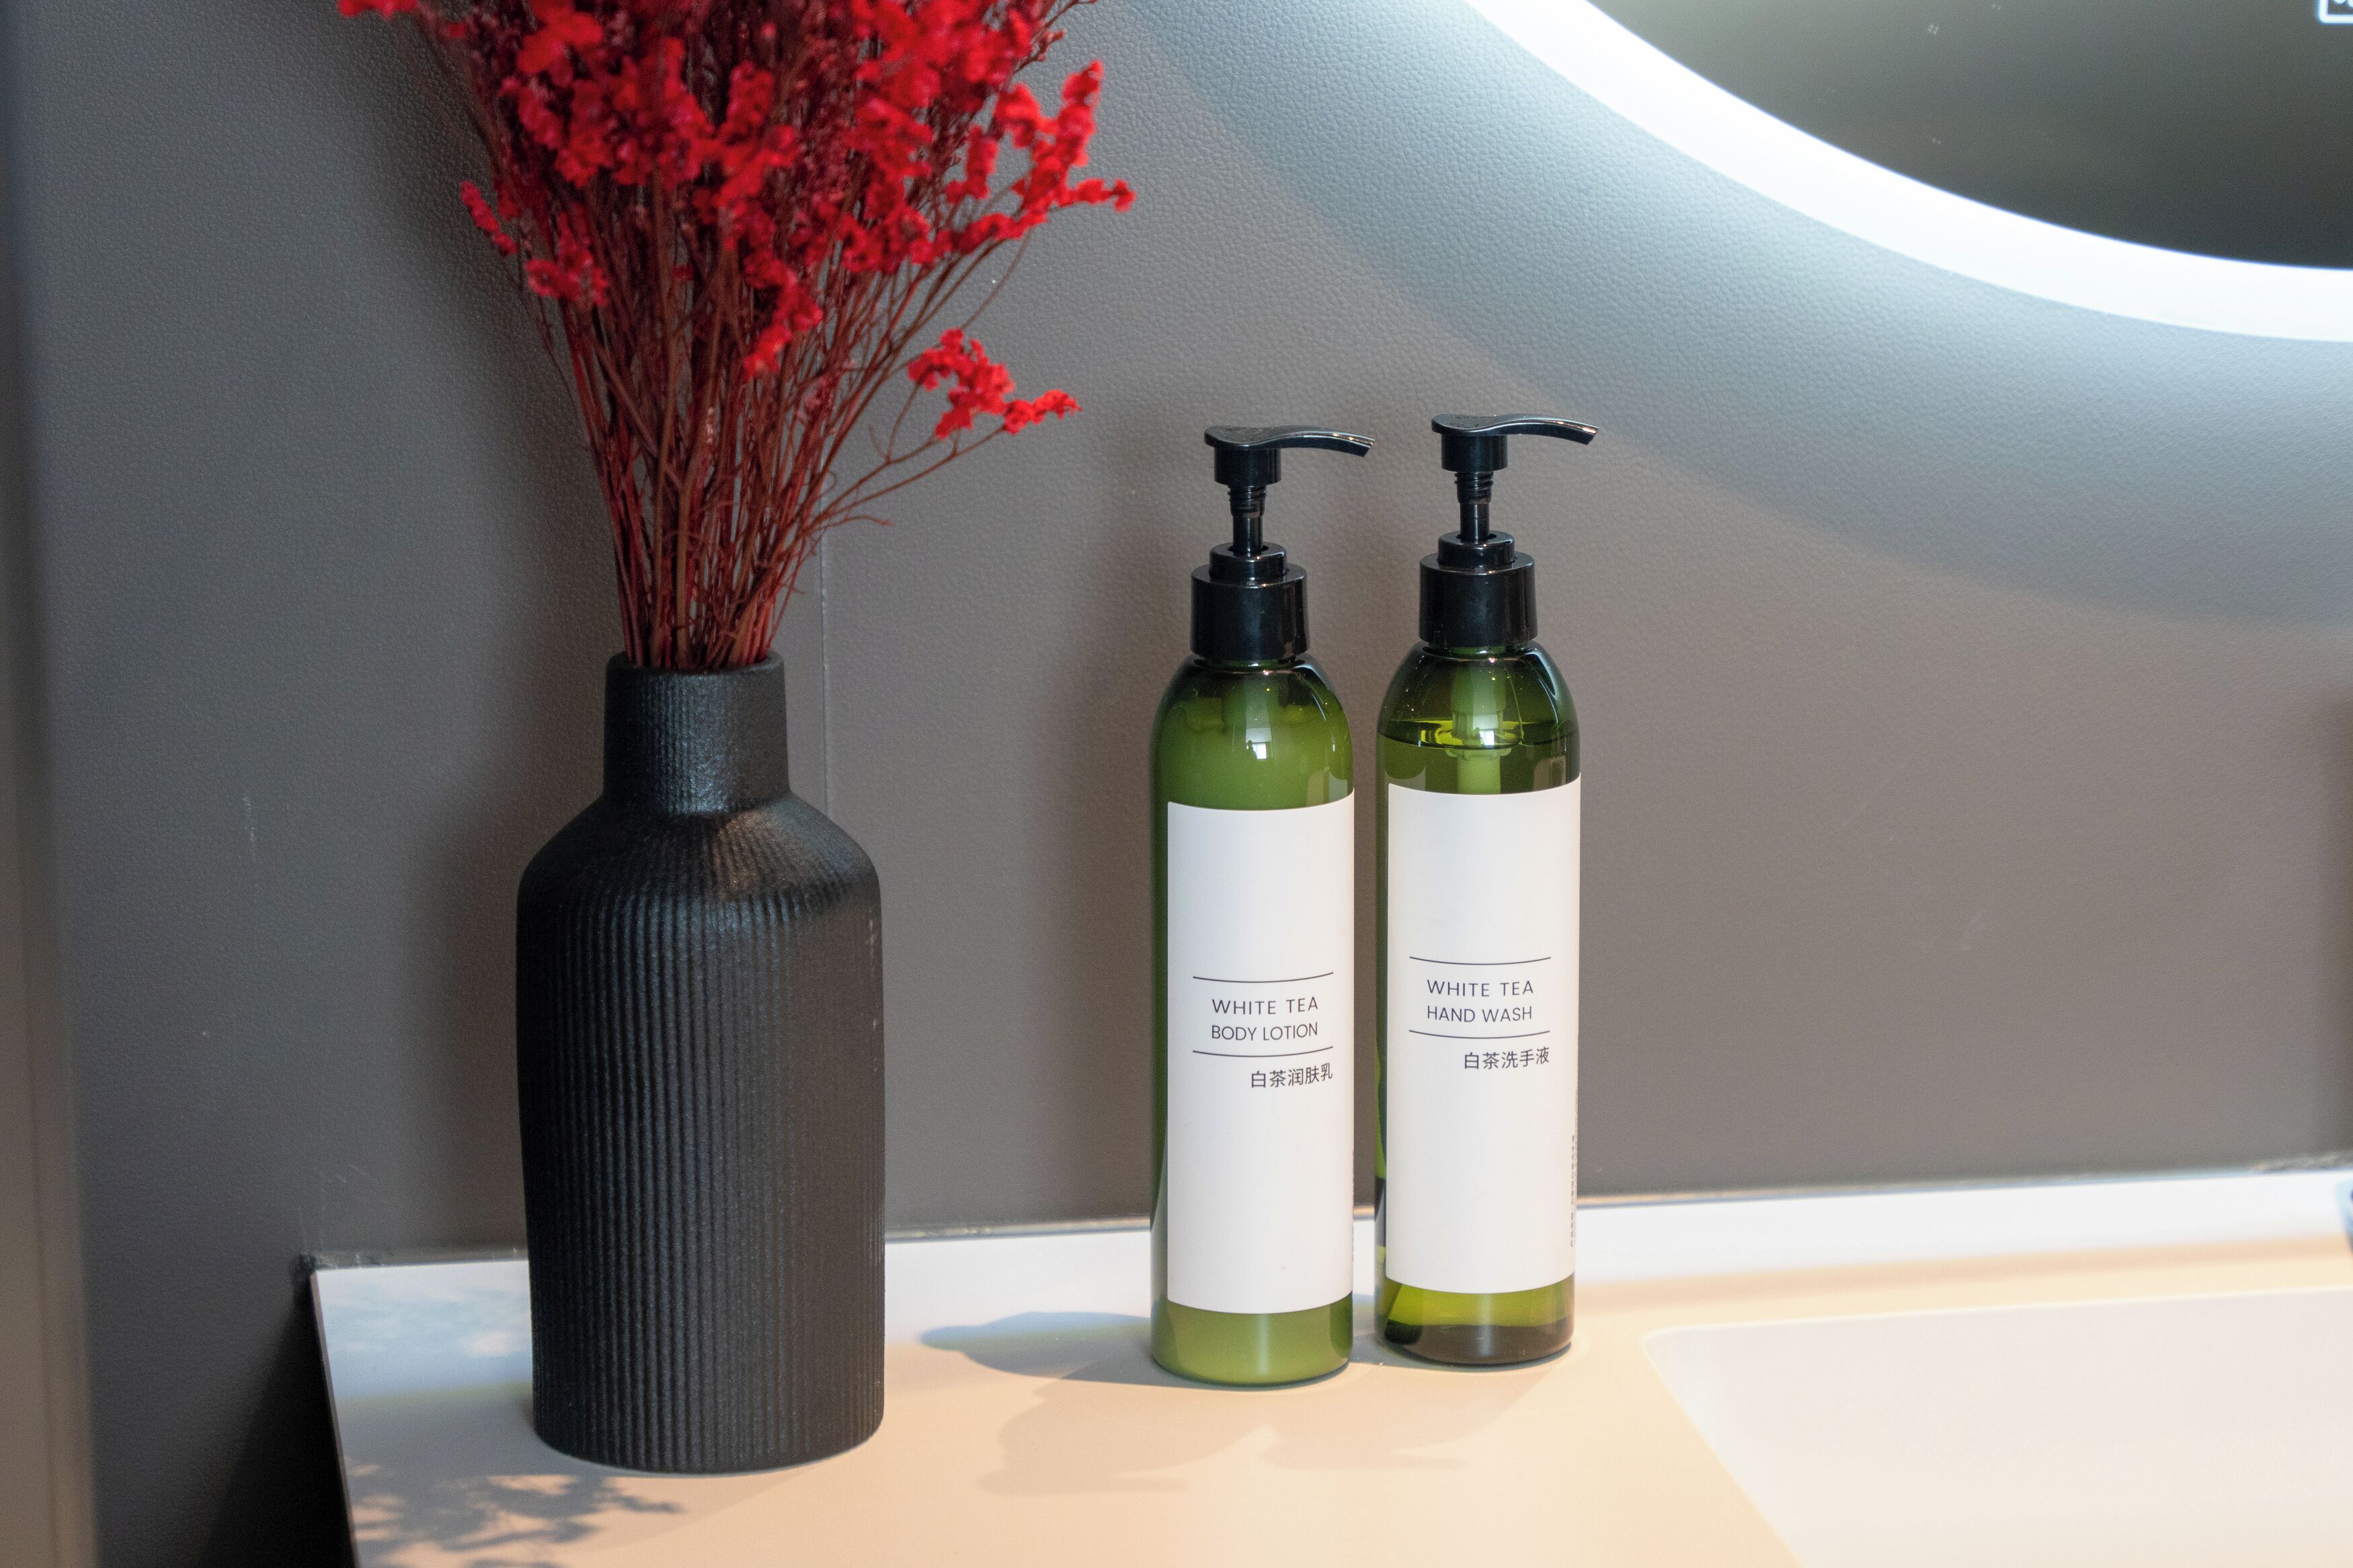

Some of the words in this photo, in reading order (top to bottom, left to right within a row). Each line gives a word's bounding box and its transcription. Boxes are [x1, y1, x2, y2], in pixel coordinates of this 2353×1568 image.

[1427, 979, 1490, 997] WHITE
[1499, 980, 1533, 997] TEA
[1211, 999, 1276, 1016] WHITE
[1285, 996, 1318, 1014] TEA
[1427, 1005, 1476, 1023] HAND
[1482, 1005, 1532, 1023] WASH
[1211, 1024, 1257, 1041] BODY
[1263, 1022, 1318, 1041] LOTION
[1464, 1046, 1550, 1070] 白茶洗手液
[1251, 1062, 1333, 1089] 白茶润肤乳
